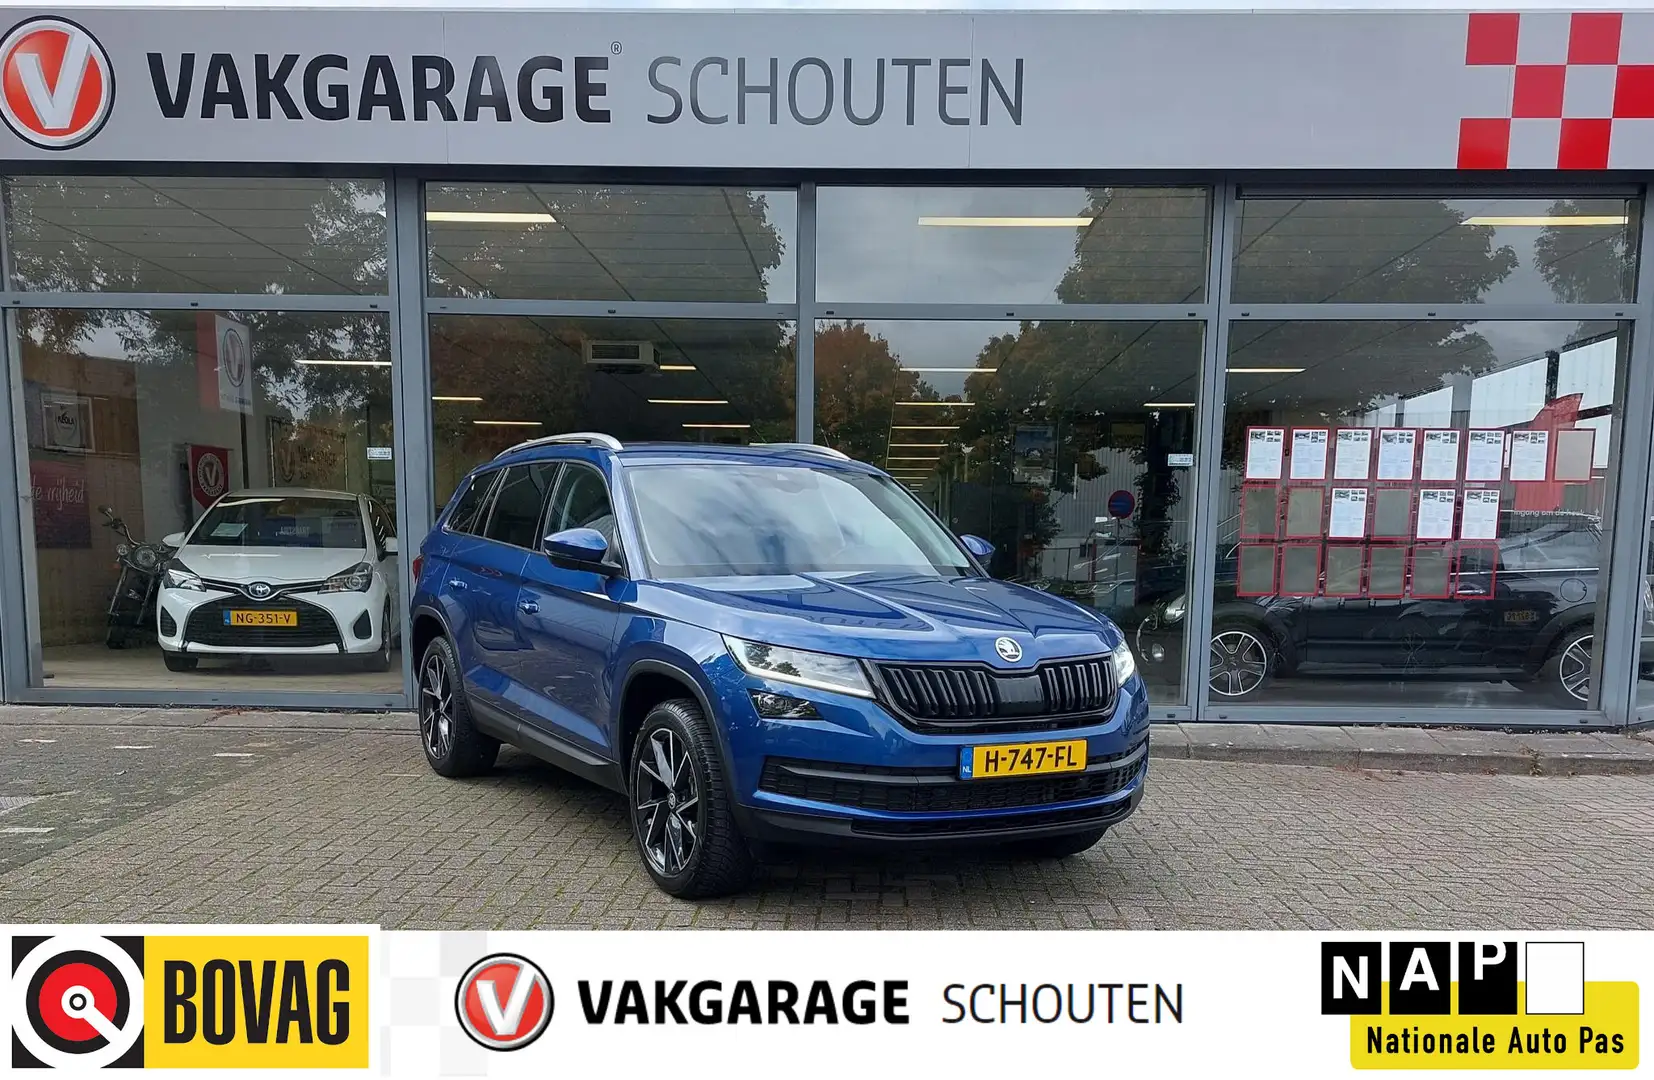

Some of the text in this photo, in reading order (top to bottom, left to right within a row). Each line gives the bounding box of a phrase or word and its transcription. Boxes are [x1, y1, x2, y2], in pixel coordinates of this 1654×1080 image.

[146, 52, 1024, 126] VAKGARAGE SCHOUTEN
[236, 613, 291, 624] NG-351-V
[962, 745, 1077, 773] NL H-747-FL
